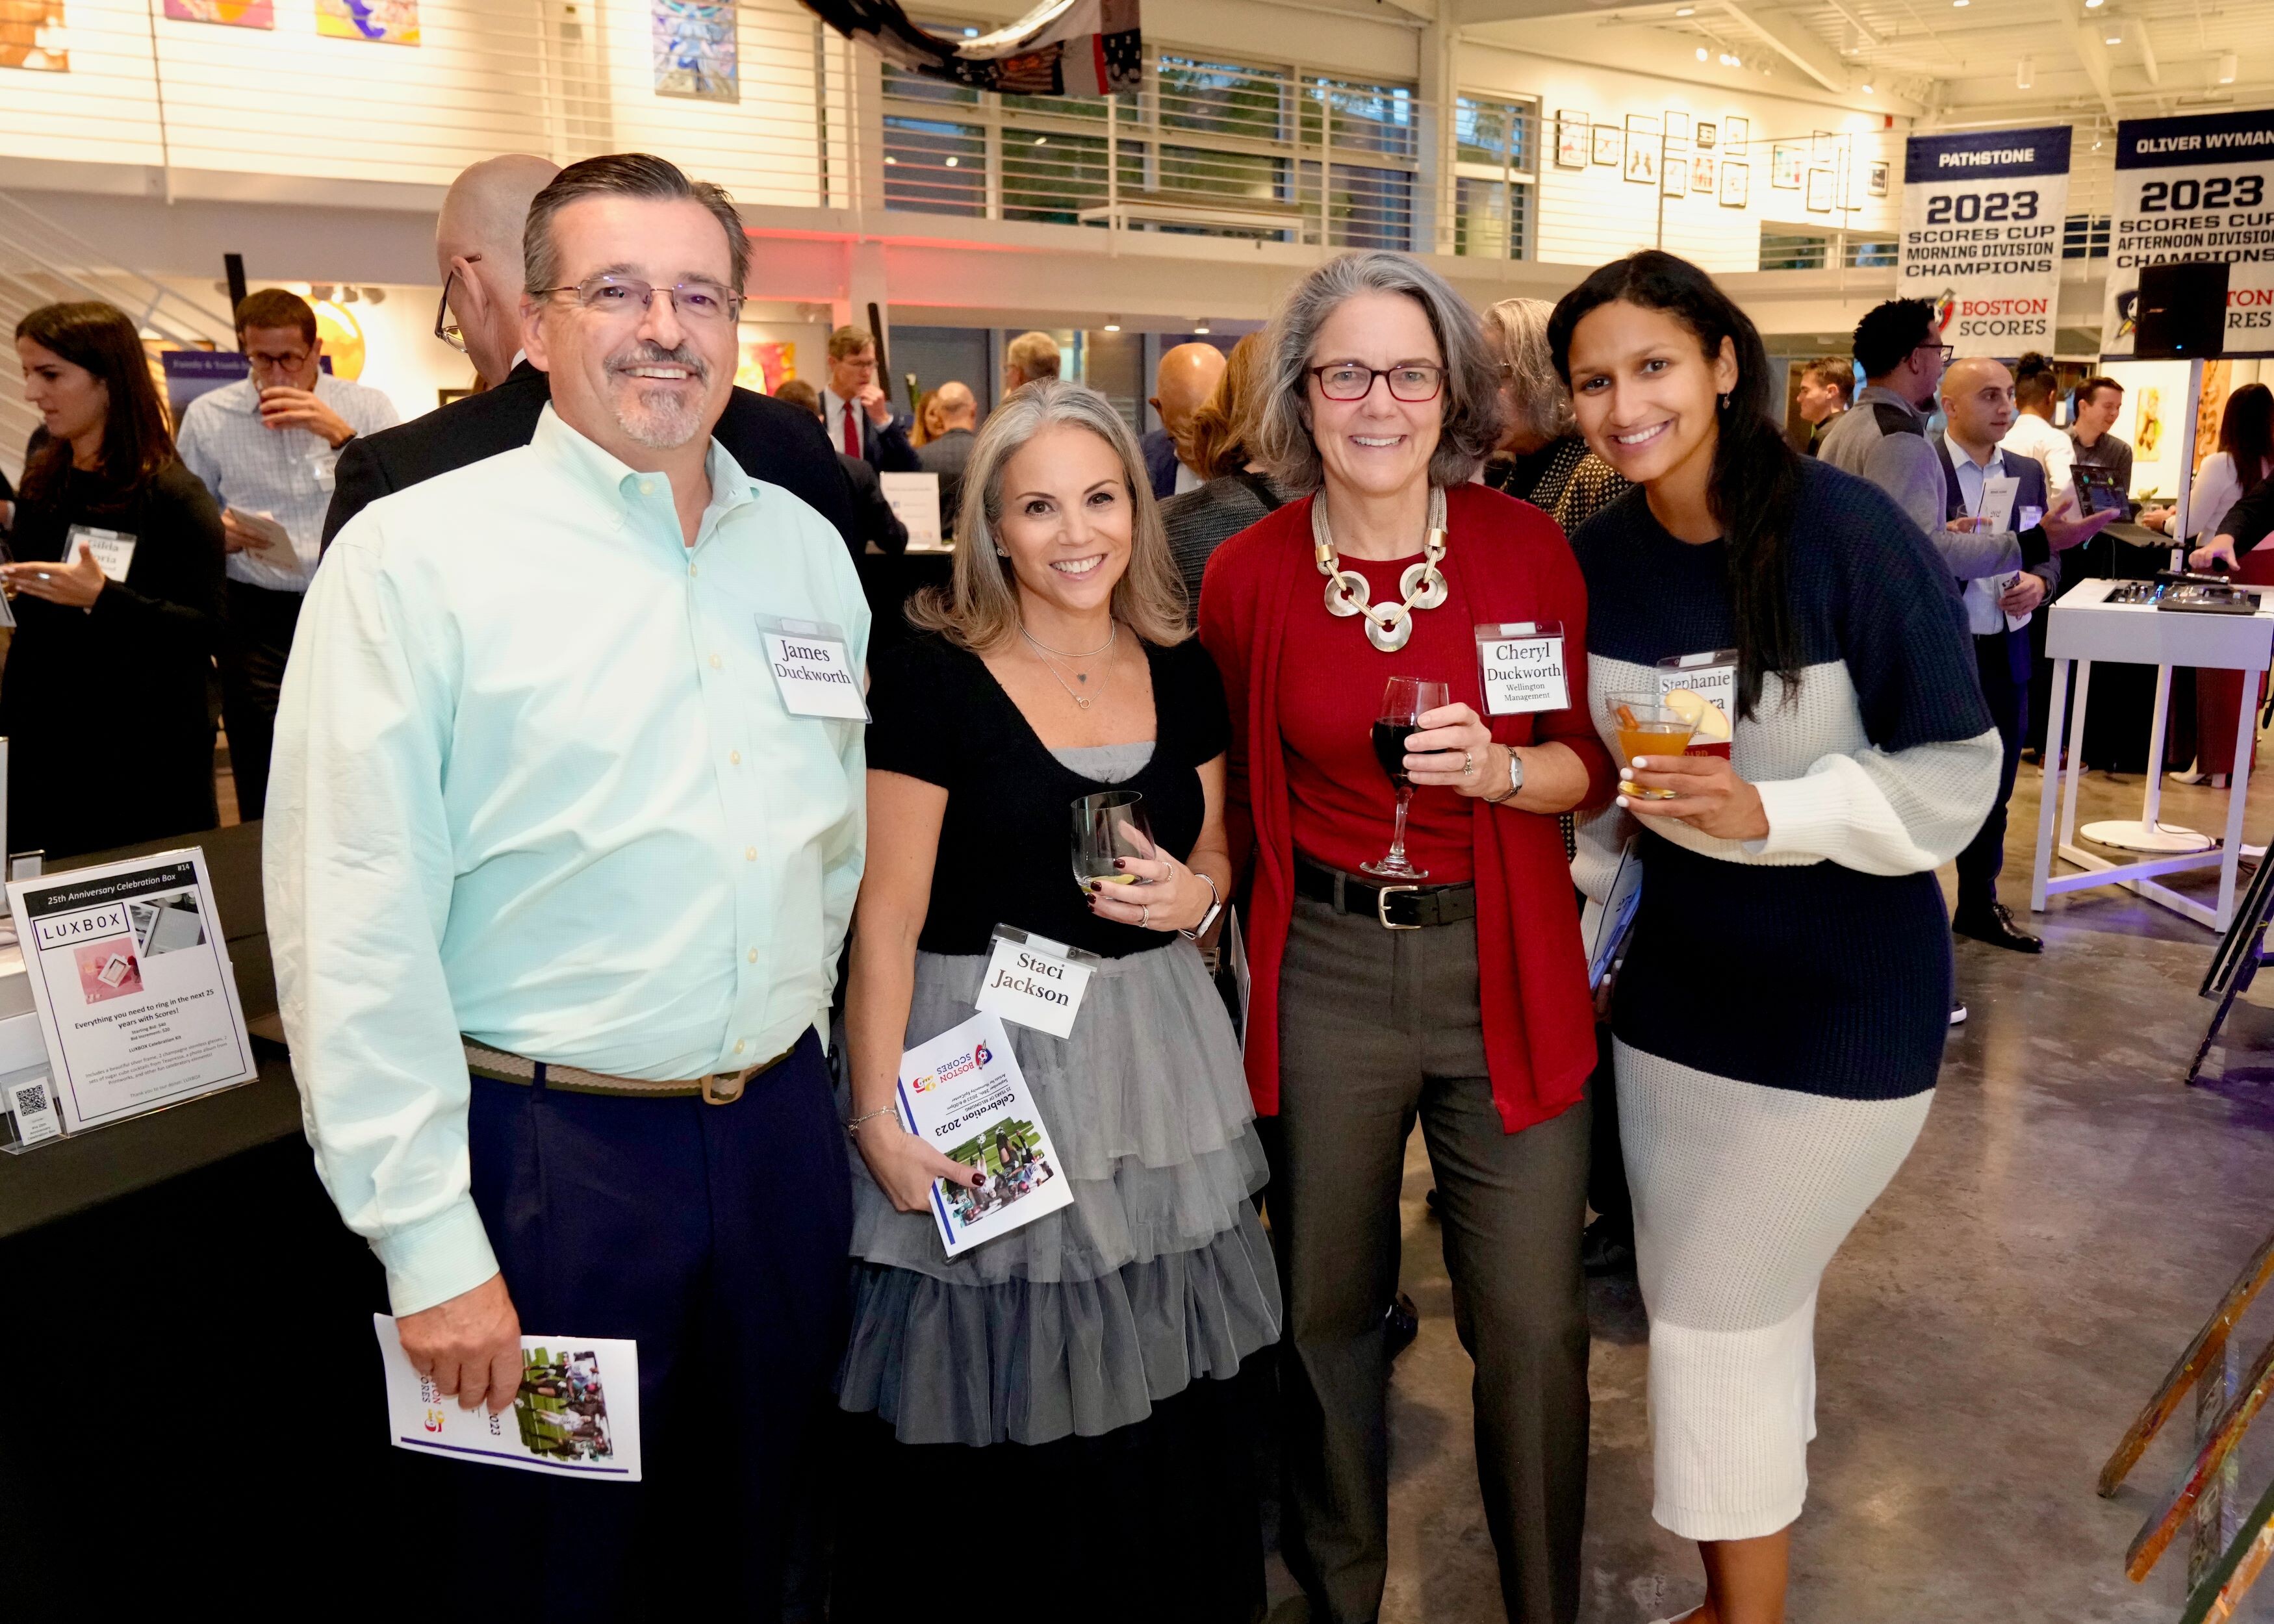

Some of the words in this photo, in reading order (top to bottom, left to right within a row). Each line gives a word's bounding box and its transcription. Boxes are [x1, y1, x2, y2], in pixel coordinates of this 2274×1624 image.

[2136, 135, 2201, 154] OLIVER
[2206, 130, 2274, 149] WYMAN
[1939, 148, 2035, 168] PATHSTONE
[2140, 175, 2264, 213] 2023
[1927, 190, 2039, 225] 2023
[2119, 215, 2219, 233] SCORES
[1908, 228, 1999, 244] SCORES
[2007, 225, 2055, 240] CUP
[2117, 233, 2203, 251] AFTERNOON
[1907, 245, 1977, 260] MORNING
[1982, 242, 2053, 257] DIVISION
[2117, 249, 2274, 268] CHAMPIONS
[1906, 260, 2052, 277] CHAMPIONS
[1961, 299, 2048, 316] BOSTON
[2227, 290, 2273, 307] TON
[1960, 320, 2046, 336] SCORES
[2227, 311, 2271, 329] RES
[780, 640, 830, 662] James
[1496, 642, 1550, 663] Cheryl
[774, 663, 852, 684] Duckworth
[1487, 663, 1561, 681] Duckworth
[1661, 671, 1730, 693] Stephanie
[1504, 692, 1550, 702] Management
[177, 863, 190, 872] #14
[47, 895, 66, 905] 25th
[68, 886, 116, 902] Anniversary
[116, 876, 160, 891] Celebration
[162, 873, 176, 882] Box
[44, 913, 120, 939] LUXBOX
[1017, 952, 1065, 980] Staci
[990, 969, 1069, 1007] Jackson
[75, 1016, 112, 1029] Everything
[114, 1012, 127, 1021] you
[128, 1006, 146, 1015] need
[118, 1019, 137, 1029] years
[138, 1014, 153, 1022] with
[155, 1008, 179, 1019] Scores!
[138, 1030, 161, 1039] Increment:
[129, 1044, 147, 1052] LUXBOX
[148, 1037, 174, 1047] Celebration
[109, 1062, 130, 1071] beautiful
[162, 1047, 187, 1057] champagne
[166, 1059, 190, 1069] celebratory
[936, 1053, 971, 1074] SCORES
[939, 1061, 975, 1083] BOSTON
[971, 1082, 990, 1093] Humanity
[990, 1078, 1008, 1090] September
[951, 1091, 971, 1102] EpiCenter
[994, 1089, 1006, 1098] YEARS
[947, 1101, 962, 1110] 6:00pm
[962, 1093, 1015, 1121] Celebration
[965, 1098, 988, 1111] BELONGING
[935, 1119, 961, 1136] 2023
[420, 1377, 430, 1402] ORES
